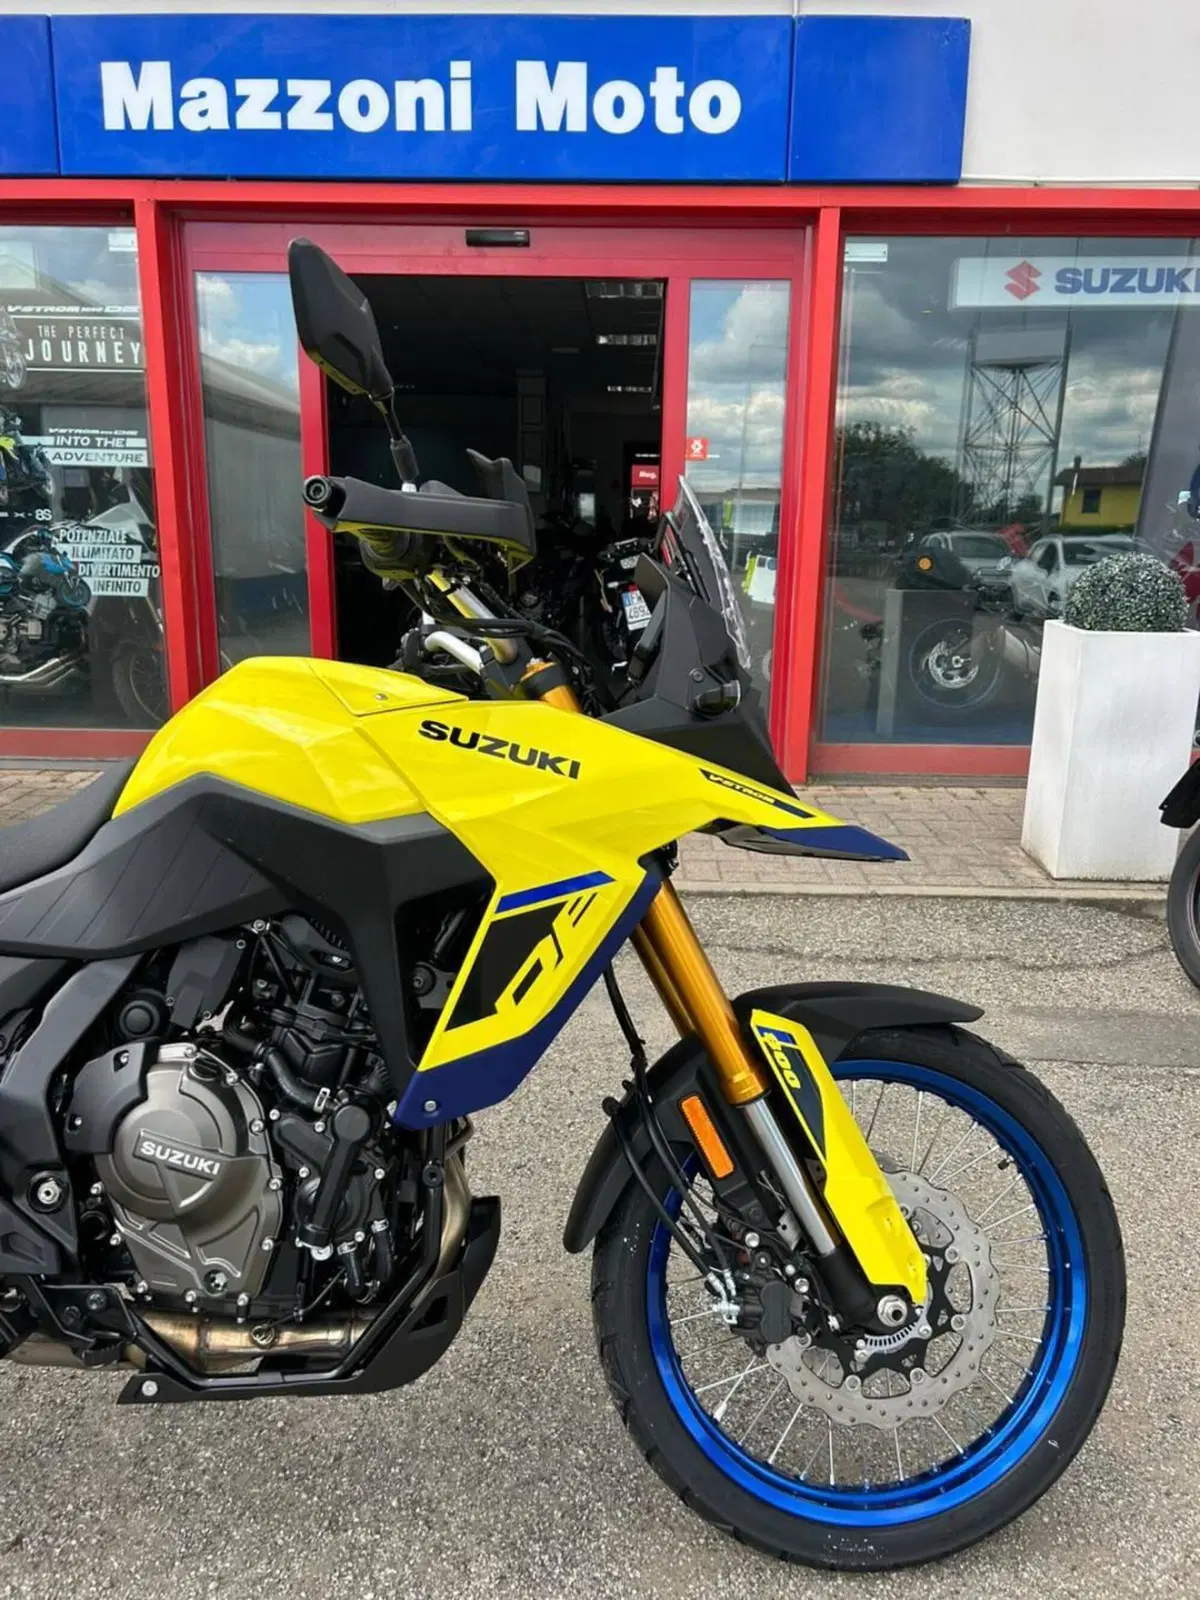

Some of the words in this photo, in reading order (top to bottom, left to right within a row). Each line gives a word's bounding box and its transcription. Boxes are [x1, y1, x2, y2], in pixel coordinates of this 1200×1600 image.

[100, 60, 472, 133] Mazzoni
[516, 60, 742, 134] Moto
[38, 325, 57, 338] THE
[68, 326, 125, 339] PERFECT
[25, 339, 141, 364] JOURNEY
[56, 436, 91, 446] INTO
[95, 437, 125, 447] THE
[52, 452, 144, 463] ADVENTURE
[59, 529, 127, 544] POTENZIALE
[72, 545, 135, 560] ILLIMITATO
[78, 564, 160, 578] DIVERTIMENTO
[93, 580, 142, 593] INFINITO
[418, 719, 581, 780] SUZUKI
[140, 1140, 220, 1175] SUZUKI
